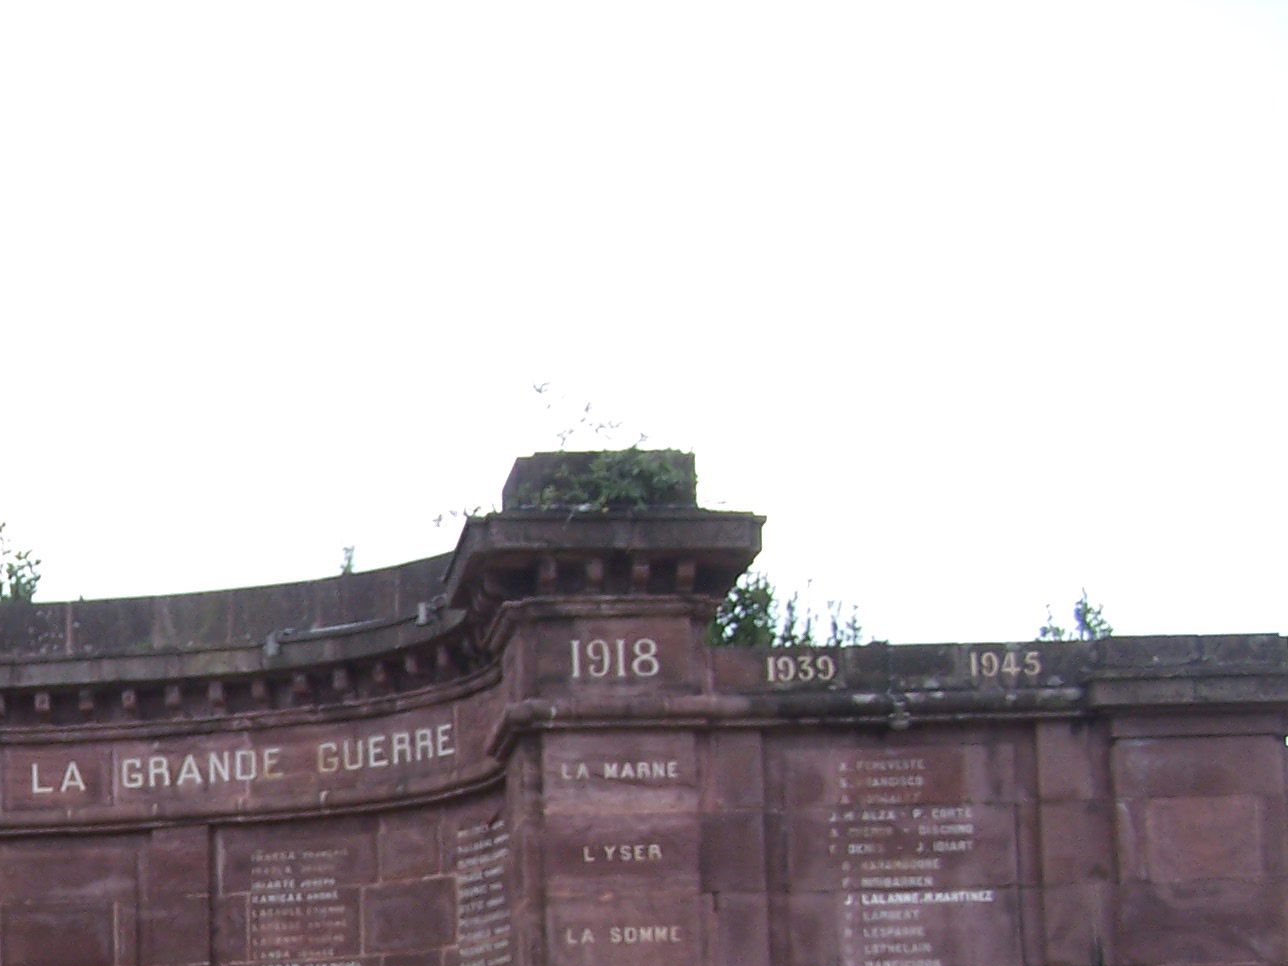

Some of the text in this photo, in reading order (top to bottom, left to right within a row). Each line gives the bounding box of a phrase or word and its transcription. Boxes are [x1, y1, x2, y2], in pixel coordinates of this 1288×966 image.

[569, 637, 660, 678] 1918
[765, 653, 836, 683] 1939
[969, 650, 1042, 678] 1945
[30, 761, 86, 796] LA
[121, 748, 284, 790] GRANDE
[317, 723, 456, 773] GUERRE
[560, 761, 679, 780] LA MARNE
[565, 925, 682, 945] LA SOMME
